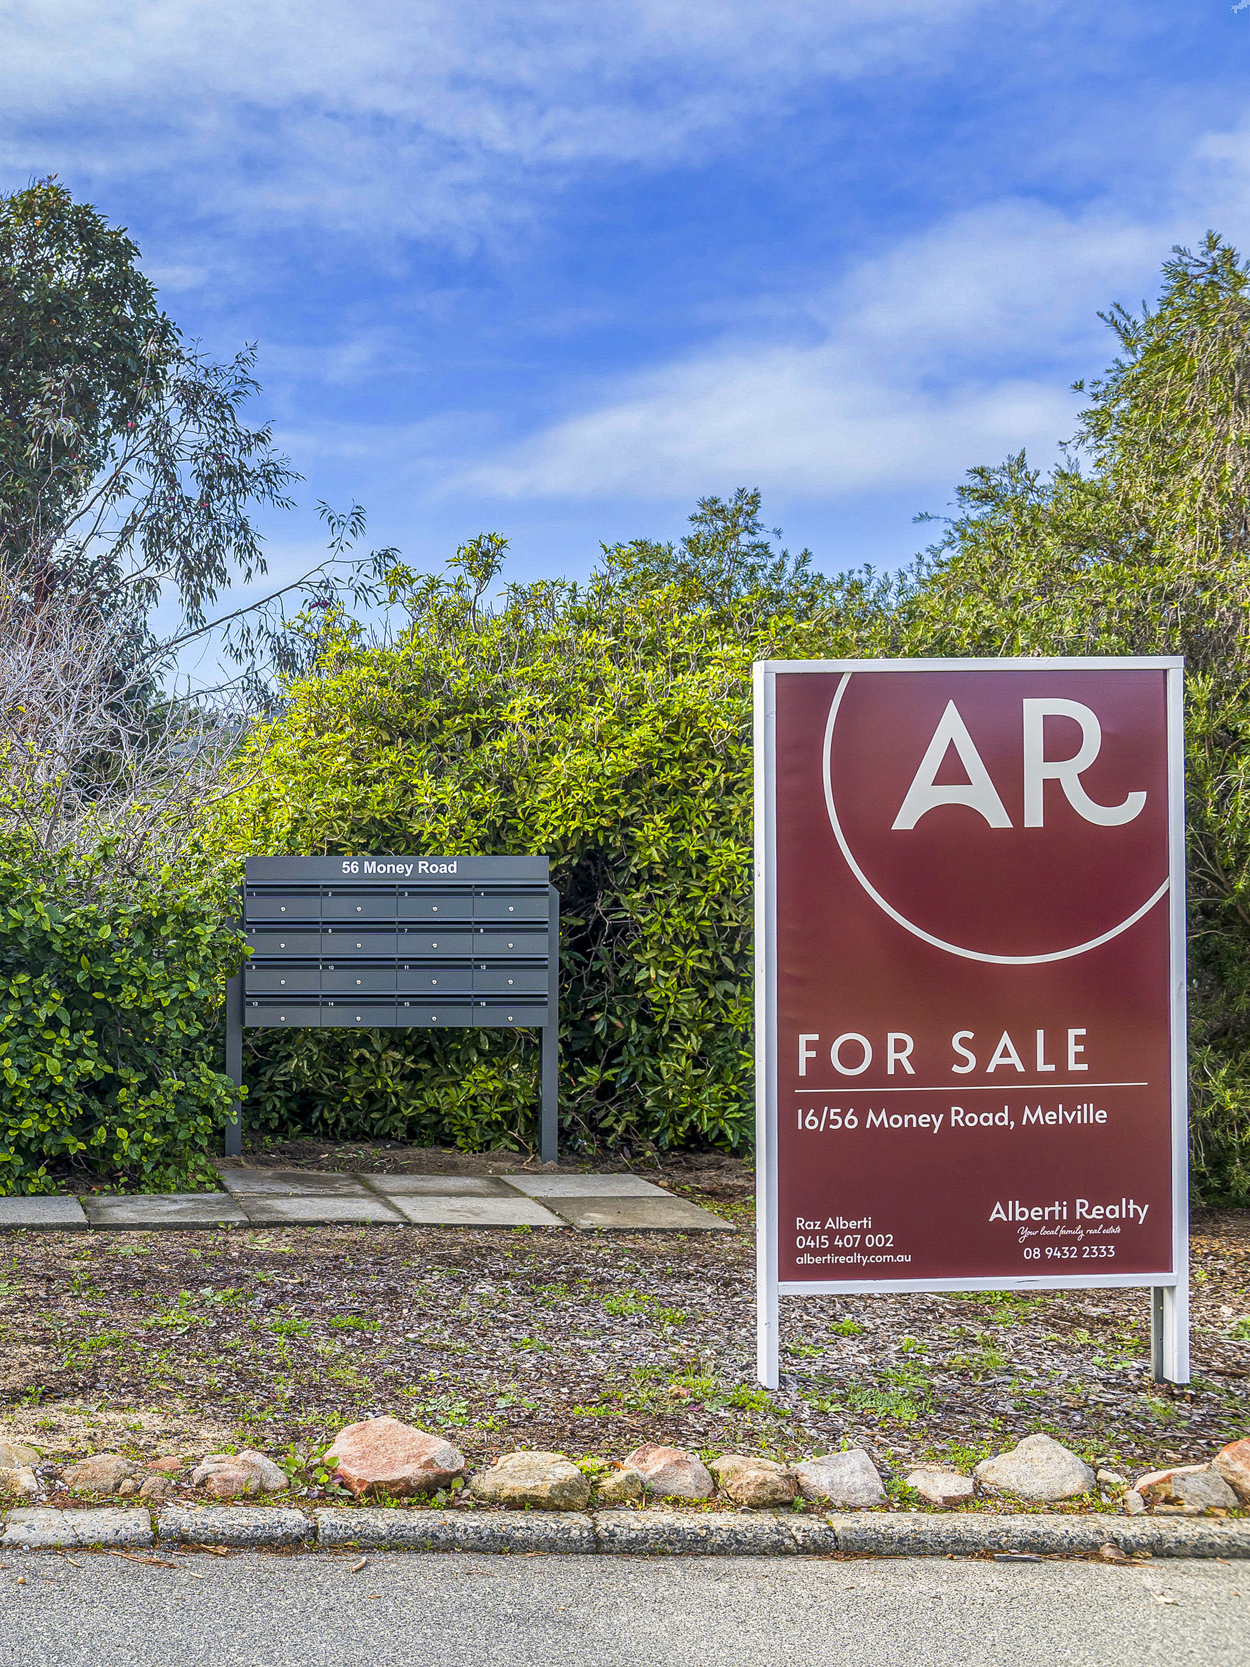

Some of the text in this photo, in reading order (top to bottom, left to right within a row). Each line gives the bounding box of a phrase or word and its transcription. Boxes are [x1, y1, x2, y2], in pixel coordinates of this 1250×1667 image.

[890, 697, 1148, 830] AR
[341, 860, 458, 877] 56 Money Road
[798, 1028, 1089, 1077] FOR SALE
[797, 1103, 1108, 1134] 16/56 Money Road, Melville
[988, 1197, 1150, 1225] Alberti Realty
[796, 1216, 872, 1230] Raz Alberti
[796, 1233, 894, 1249] 0415 407 002
[1017, 1224, 1122, 1243] Your local family real estate
[795, 1252, 912, 1267] albertirealty.com.au
[1023, 1245, 1116, 1260] 08 9432 2333
